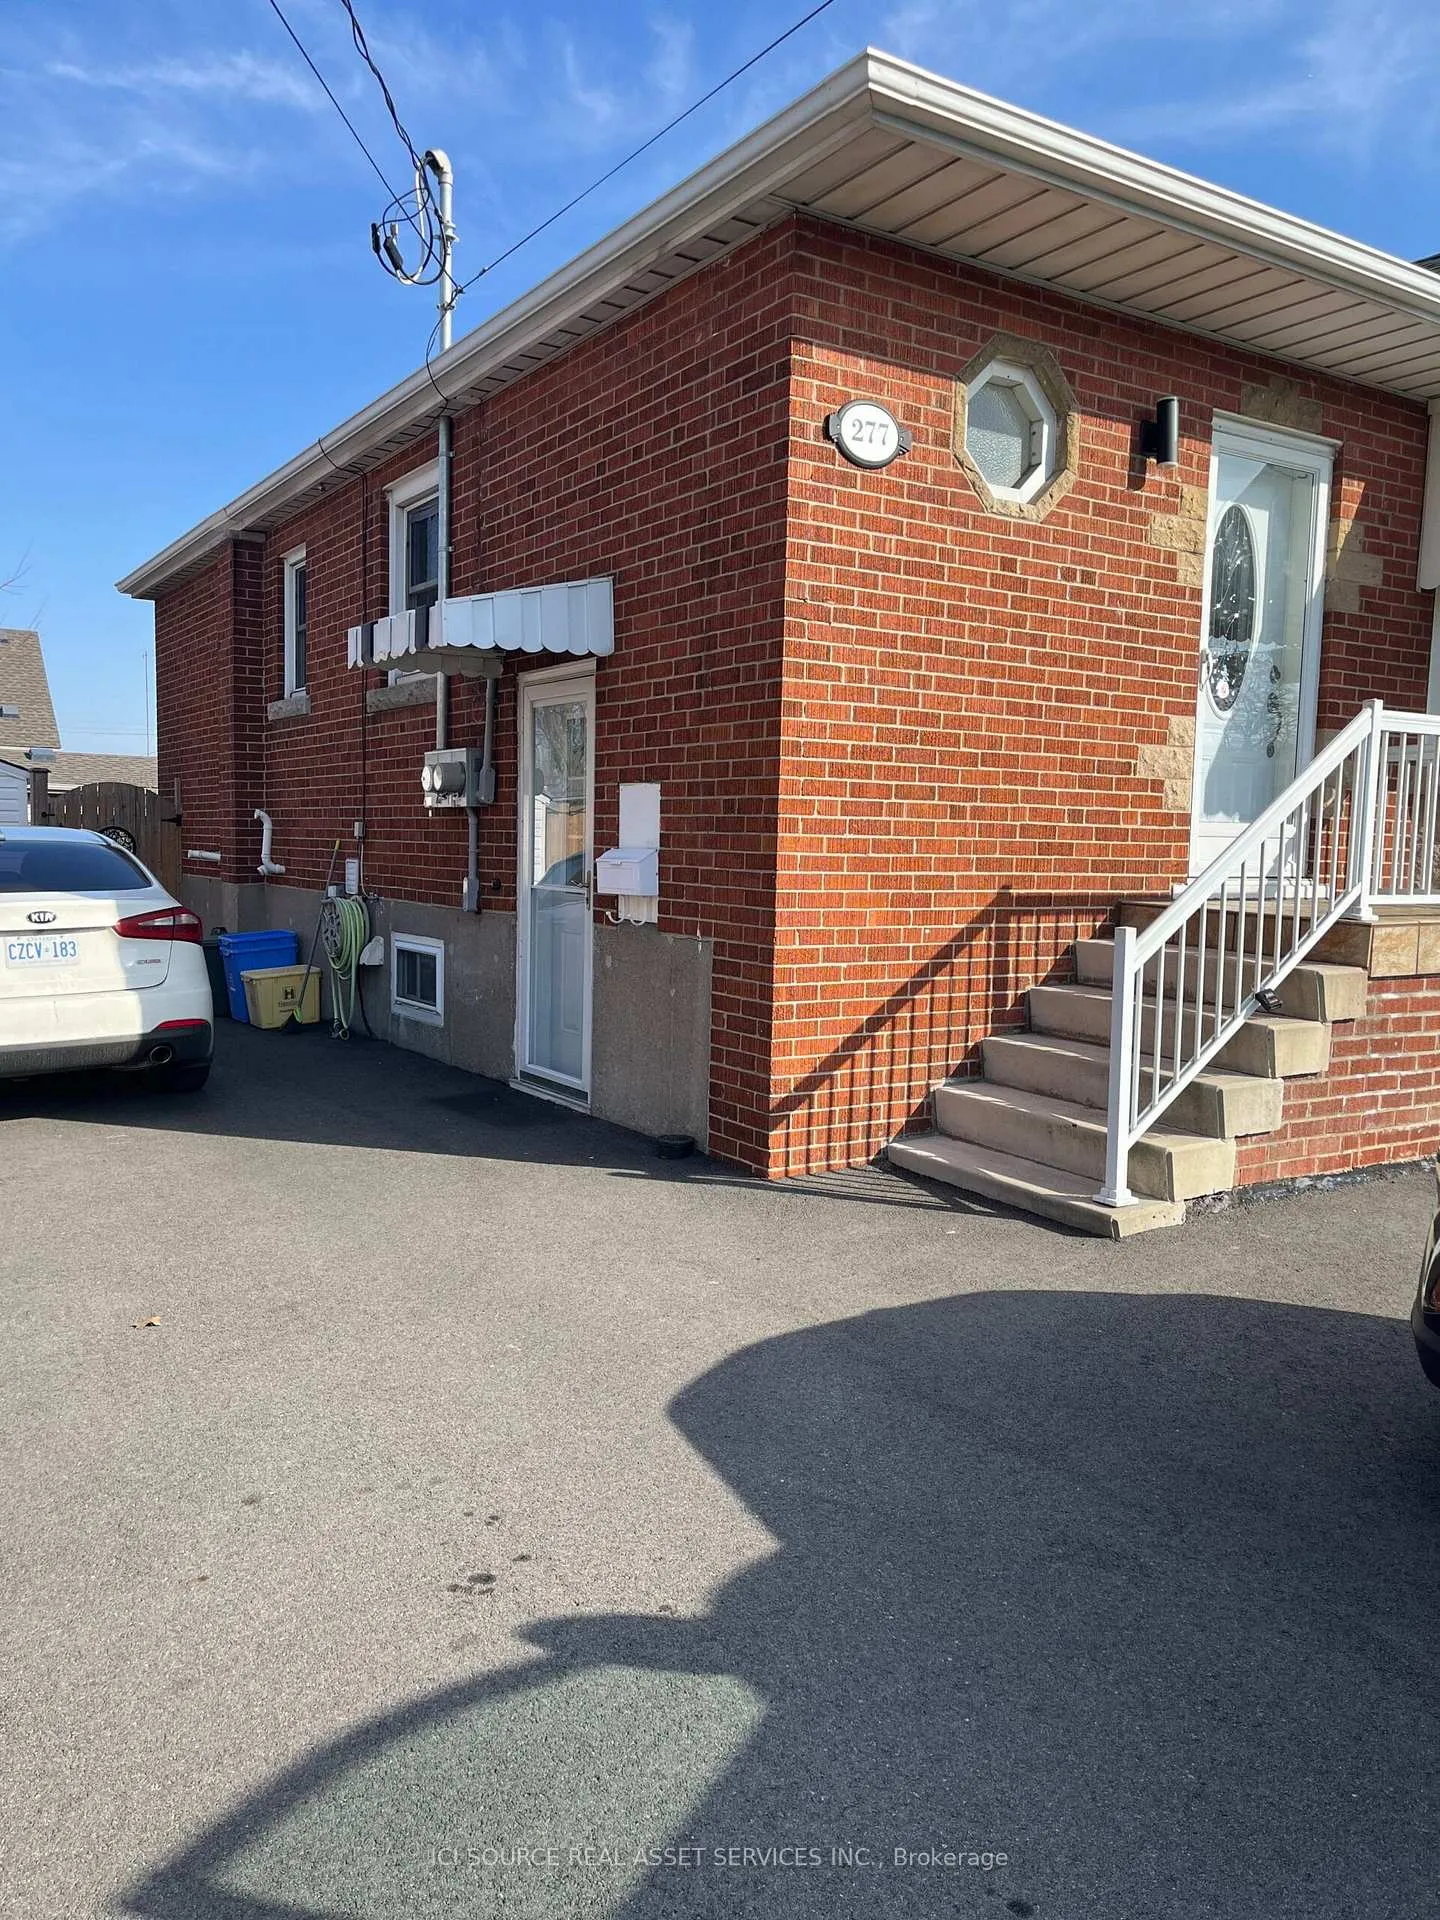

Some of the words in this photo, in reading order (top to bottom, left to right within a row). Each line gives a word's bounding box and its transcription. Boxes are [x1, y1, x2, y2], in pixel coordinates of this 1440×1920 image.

[852, 418, 889, 446] 277
[30, 911, 55, 923] KIA
[8, 942, 42, 960] CZCV
[52, 940, 77, 958] 183
